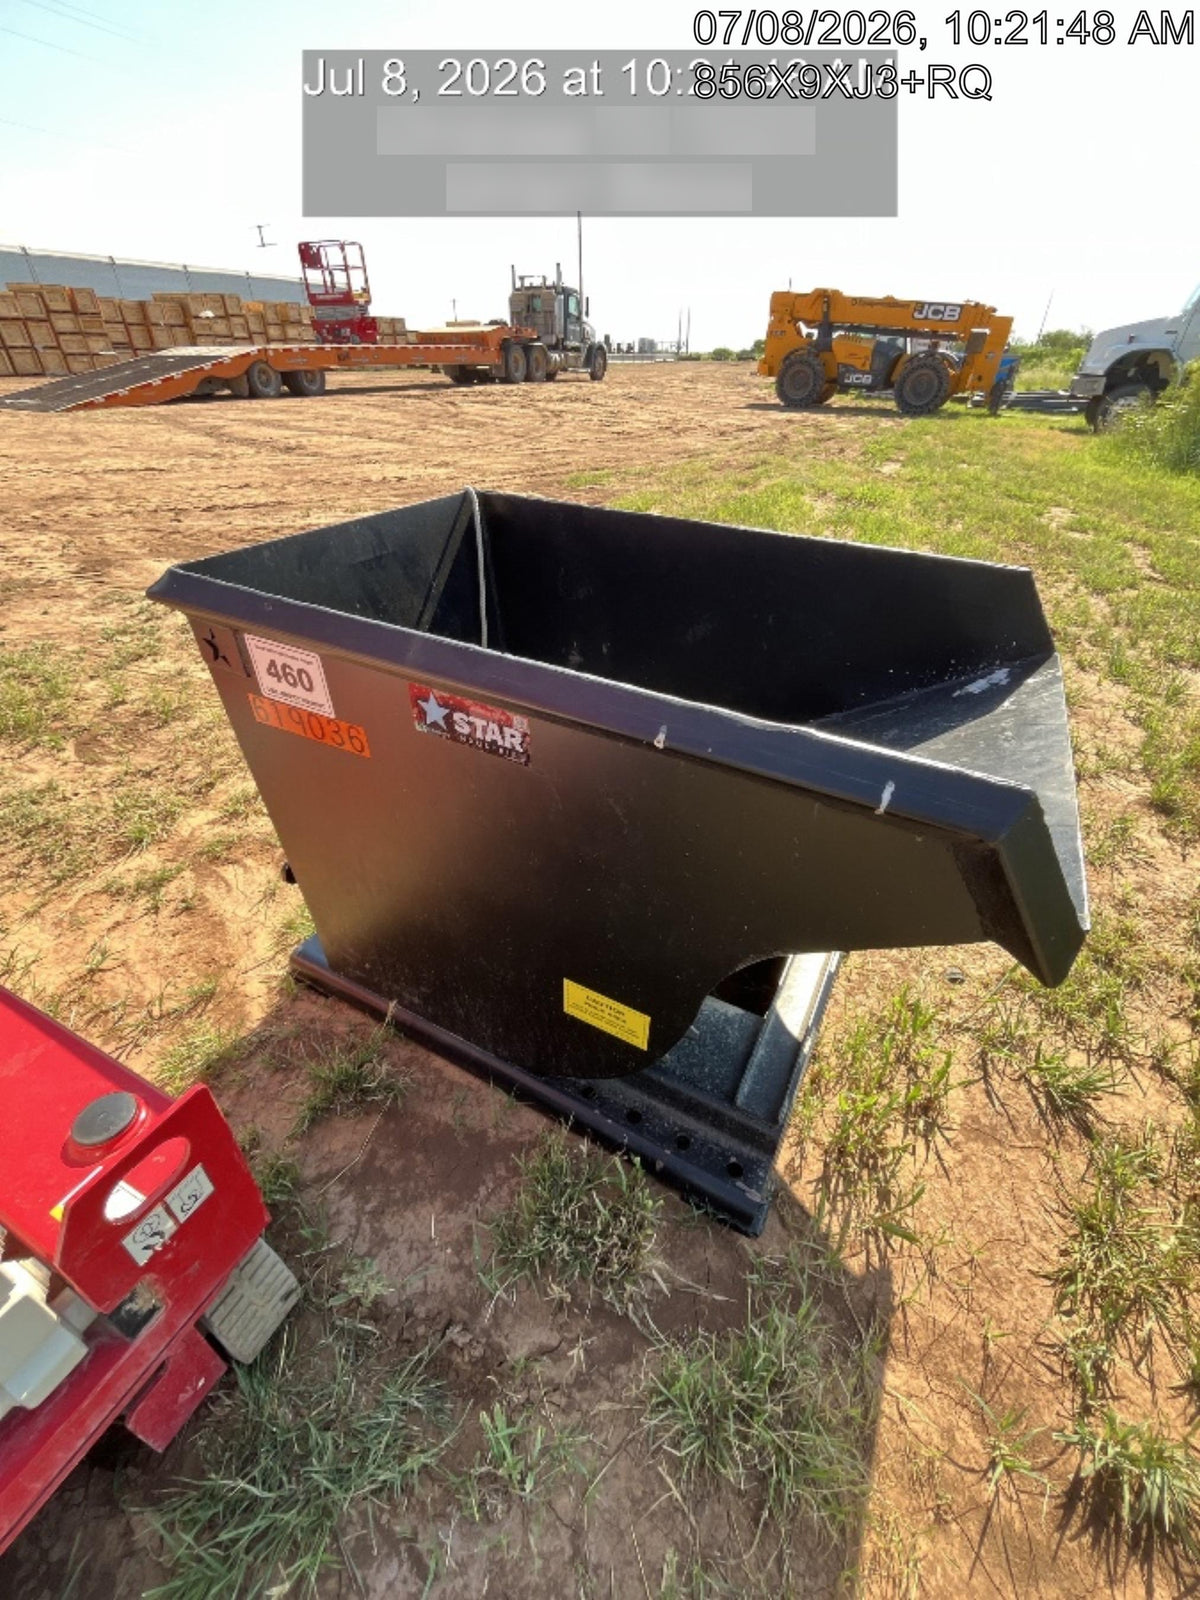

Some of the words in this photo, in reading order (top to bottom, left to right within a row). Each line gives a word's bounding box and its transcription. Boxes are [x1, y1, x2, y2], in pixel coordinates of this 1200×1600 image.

[914, 303, 962, 321] JCB
[843, 373, 873, 385] JCB
[265, 658, 314, 693] 460
[252, 694, 365, 753] 619036
[452, 711, 524, 753] STAR
